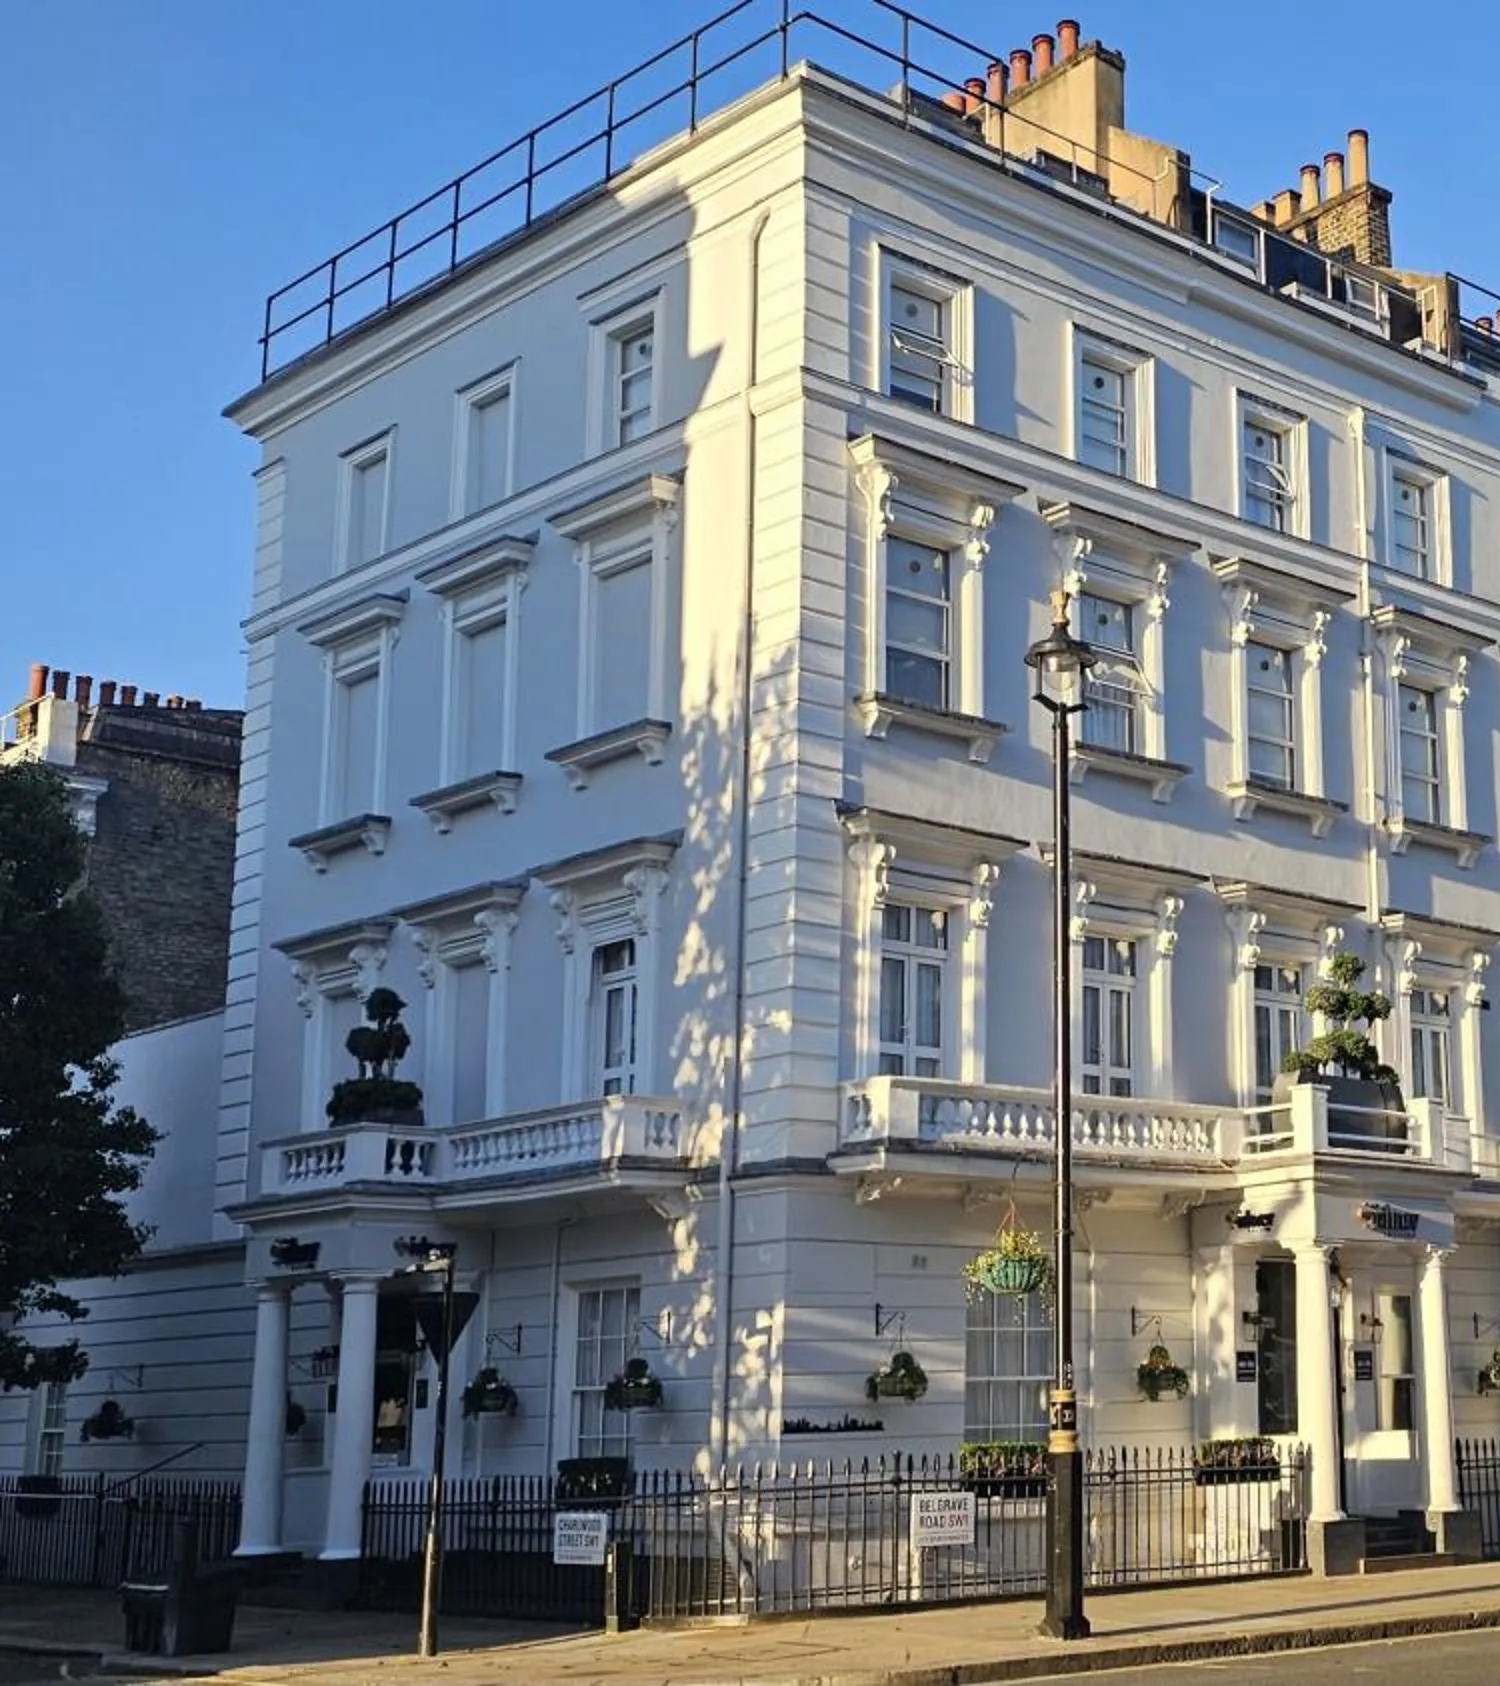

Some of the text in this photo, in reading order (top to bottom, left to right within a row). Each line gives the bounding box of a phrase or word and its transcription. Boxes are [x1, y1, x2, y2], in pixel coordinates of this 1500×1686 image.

[920, 1498, 968, 1512] BELGRAVE
[920, 1513, 969, 1528] ROAD SW1
[559, 1534, 583, 1547] STREET
